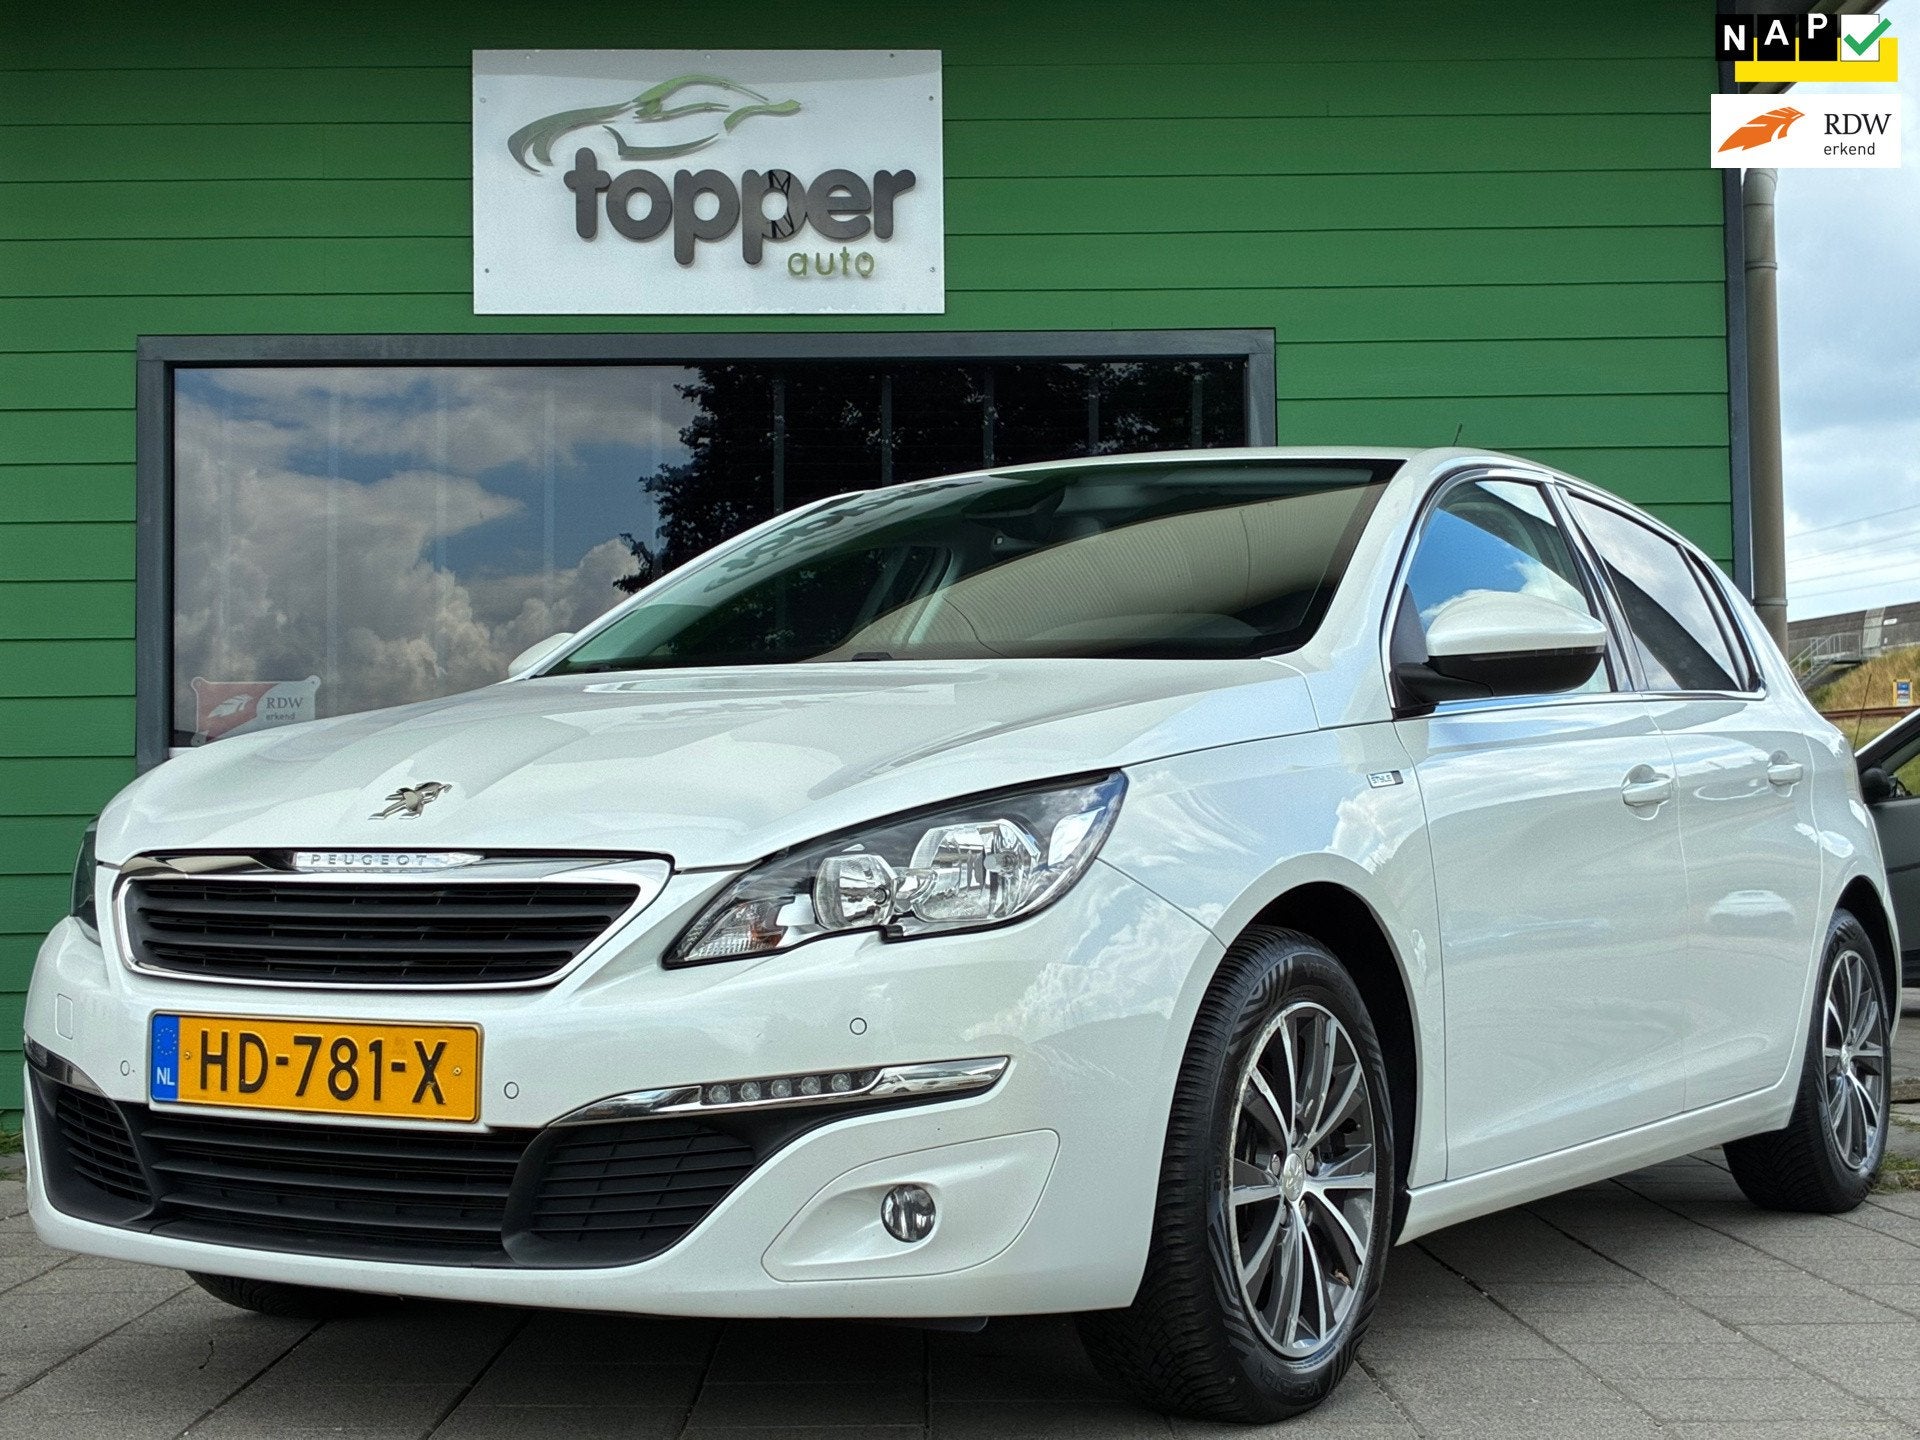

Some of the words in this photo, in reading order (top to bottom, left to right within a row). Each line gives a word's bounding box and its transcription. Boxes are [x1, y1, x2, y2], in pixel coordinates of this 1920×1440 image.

[563, 147, 916, 265] topper
[787, 246, 875, 277] auto
[266, 697, 303, 709] RDW
[265, 712, 295, 720] erkend
[310, 854, 427, 866] PEUGEOT
[157, 1067, 176, 1087] NL
[200, 1029, 447, 1105] HD-781-X
